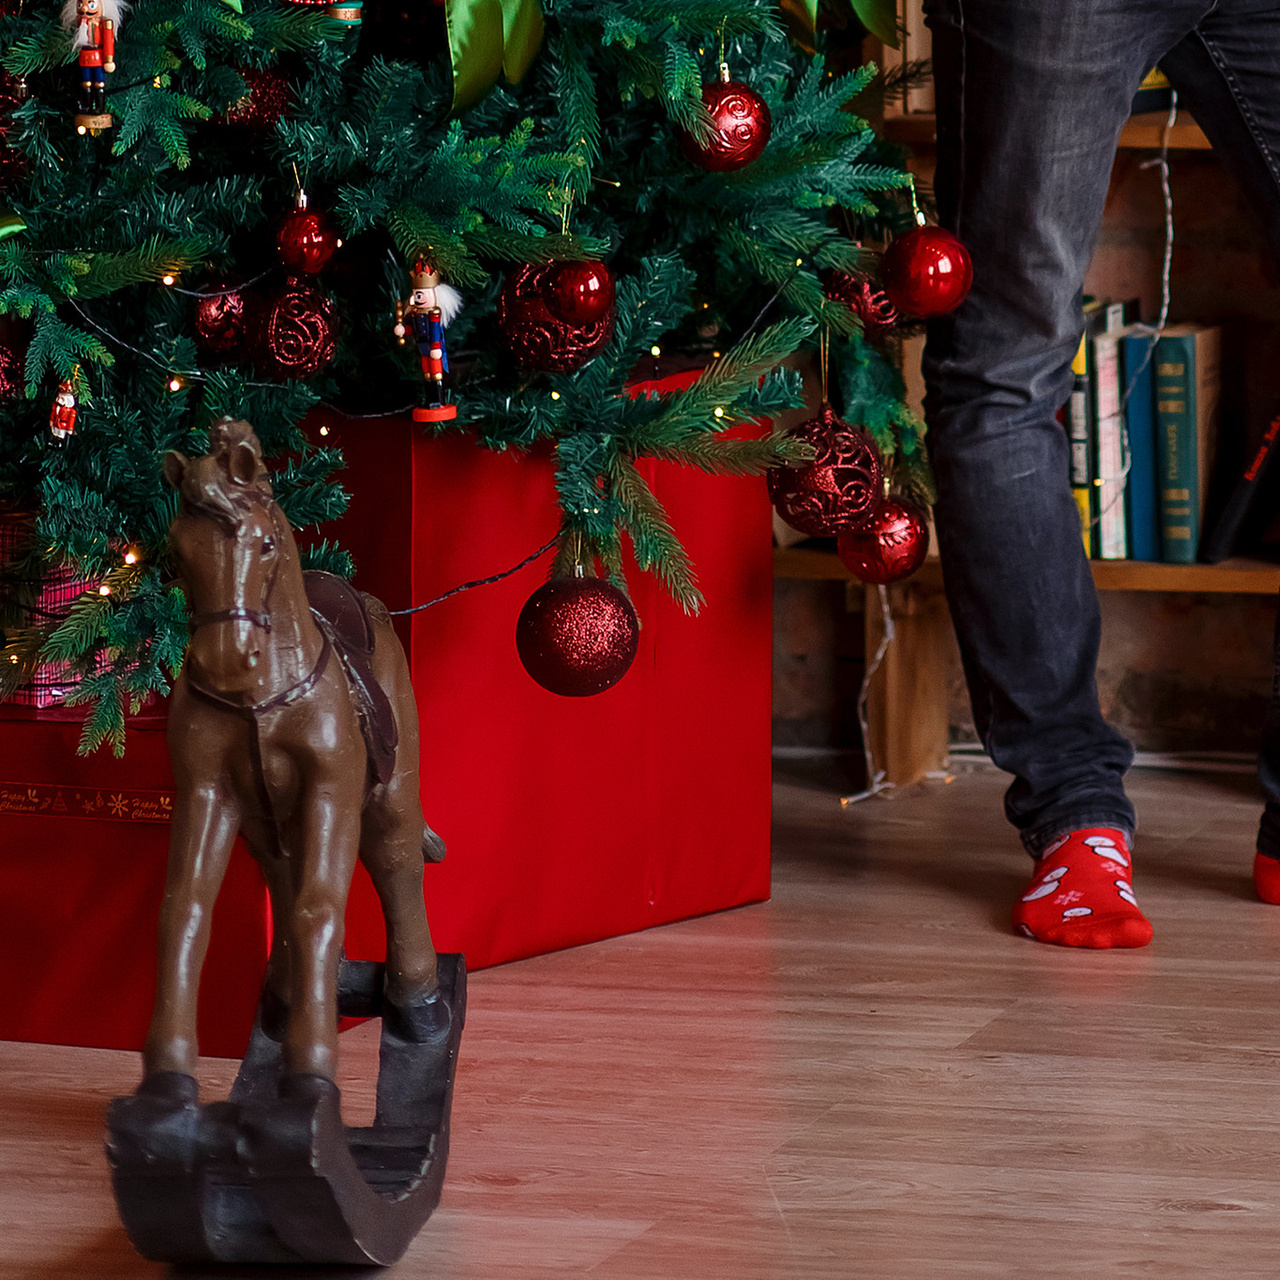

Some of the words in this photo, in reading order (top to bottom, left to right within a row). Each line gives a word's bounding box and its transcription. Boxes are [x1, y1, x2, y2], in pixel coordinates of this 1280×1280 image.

[0, 790, 26, 802] Happy
[131, 798, 160, 810] Happy
[131, 808, 170, 820] Christmas
